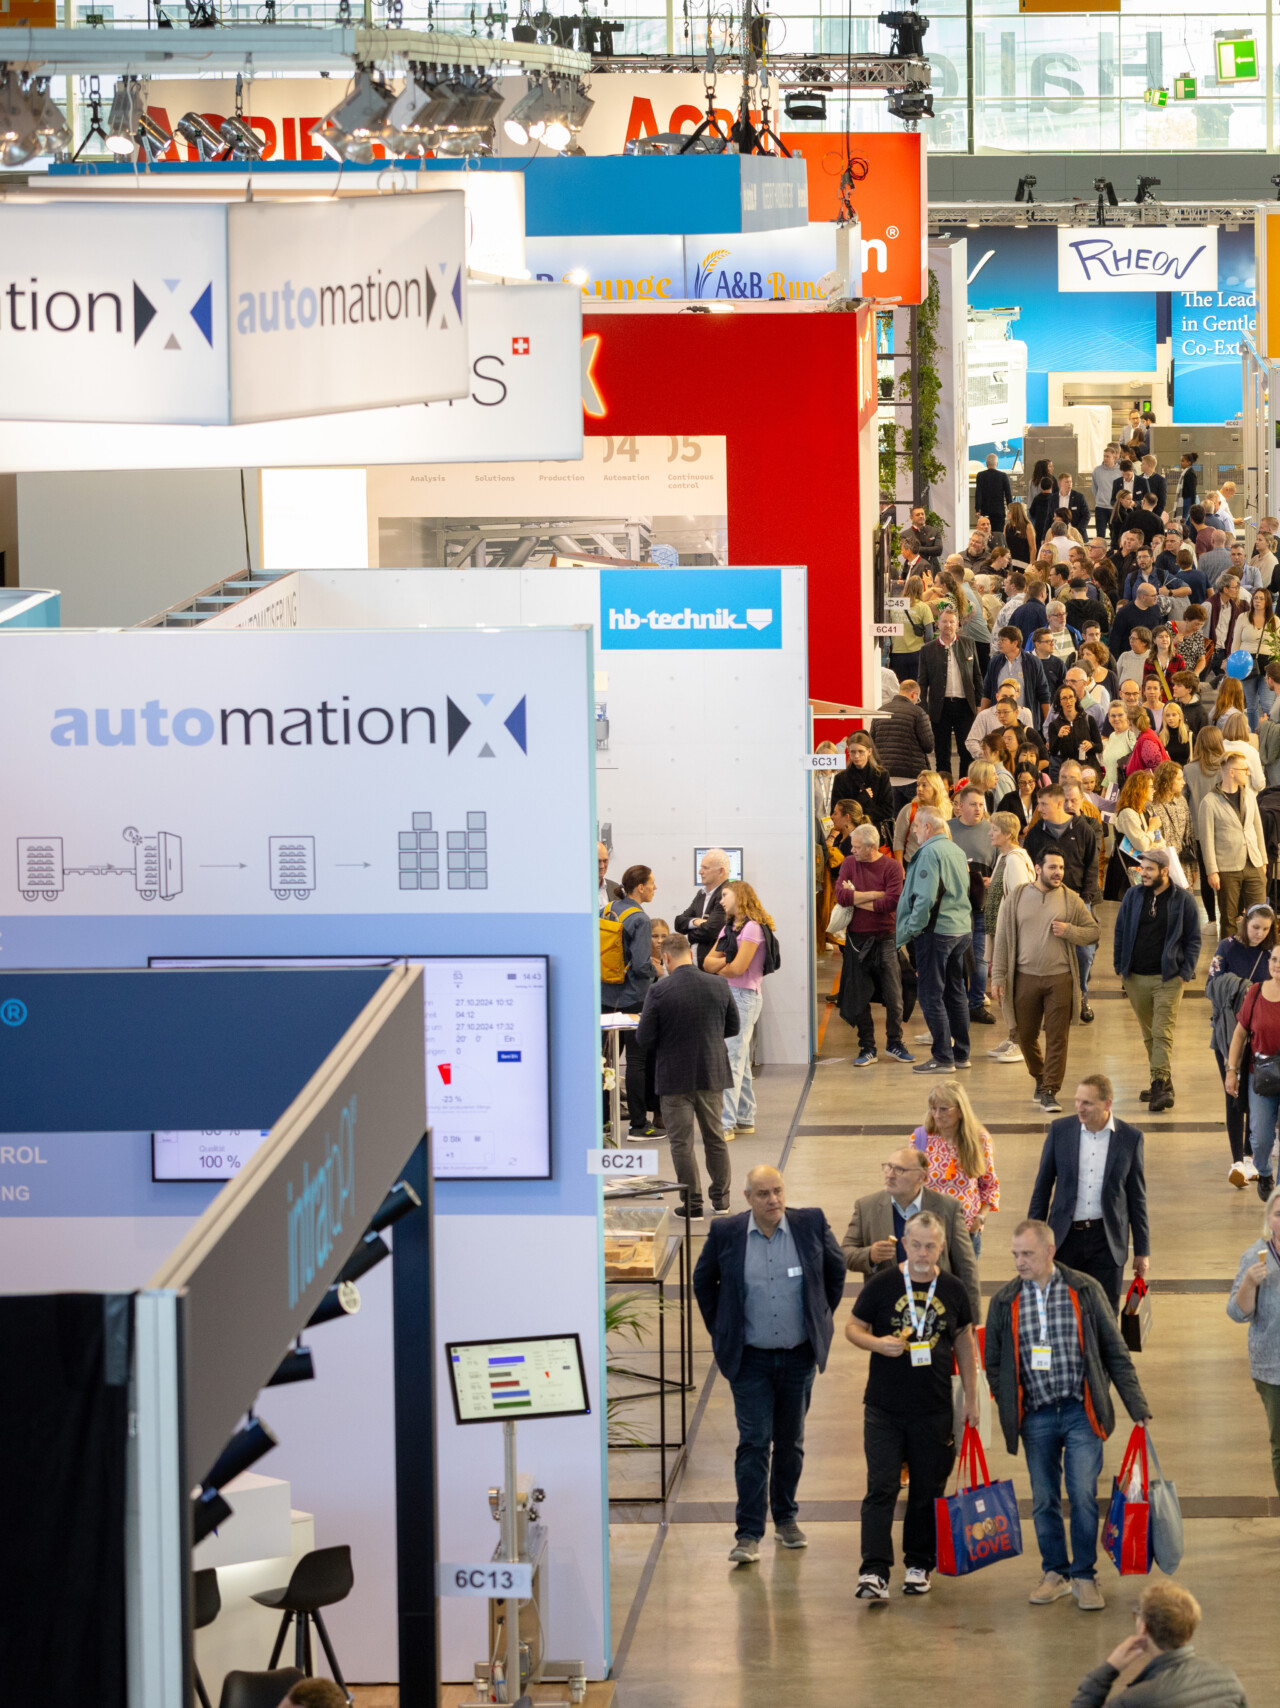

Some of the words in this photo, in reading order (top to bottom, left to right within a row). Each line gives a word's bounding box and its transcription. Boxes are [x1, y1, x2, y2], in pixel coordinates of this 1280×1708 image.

[1069, 239, 1206, 281] RHEON
[716, 271, 764, 298] A&B
[1181, 291, 1213, 307] The
[1181, 316, 1198, 331] in
[410, 474, 446, 484] Analysis
[475, 474, 515, 483] Solutions
[539, 474, 585, 482] Production
[603, 474, 650, 482] Automation
[668, 474, 714, 482] Continuous
[609, 608, 746, 630] hb-technik
[811, 757, 838, 767] 6C31
[199, 1155, 222, 1168] 100
[227, 1155, 241, 1168] %
[601, 1154, 643, 1170] 6C21
[968, 1533, 1011, 1561] LOVE
[454, 1570, 514, 1590] 6C13
